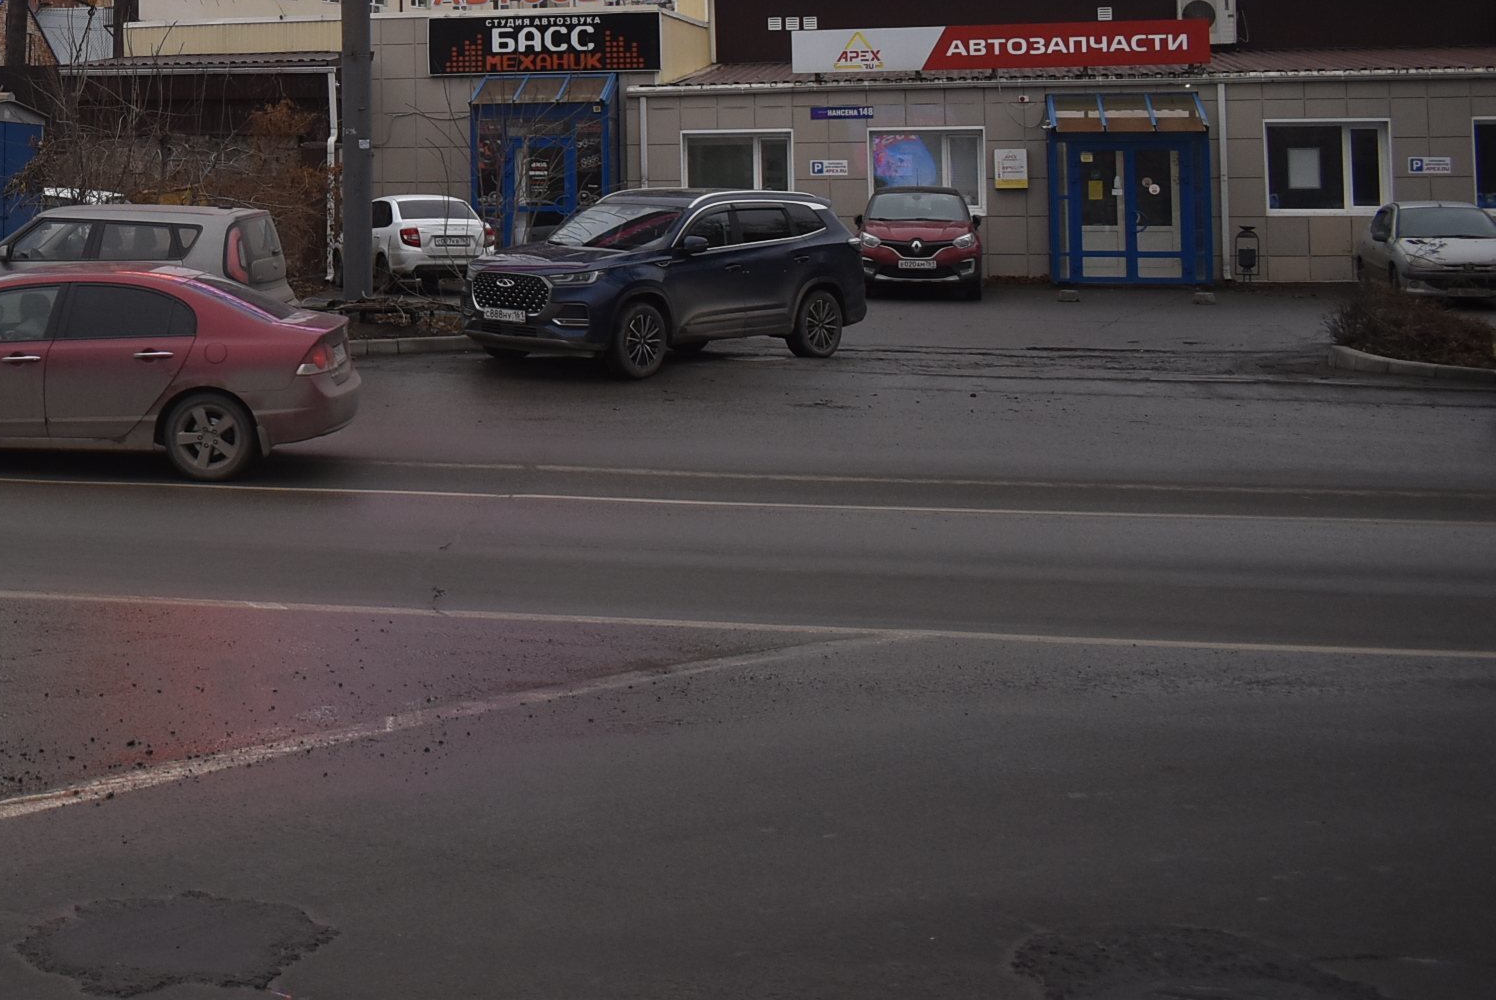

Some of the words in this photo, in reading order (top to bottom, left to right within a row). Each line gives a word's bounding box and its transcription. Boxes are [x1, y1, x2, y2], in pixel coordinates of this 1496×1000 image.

[485, 18, 530, 27] СТУДИЯ
[533, 16, 601, 26] АВТОЗВУКА
[491, 25, 595, 53] БАСС
[945, 34, 1188, 56] АВТОЗАПЧАСТИ
[486, 52, 602, 71] МЕХАНИК
[837, 50, 881, 62] APEX
[859, 107, 874, 116] 148
